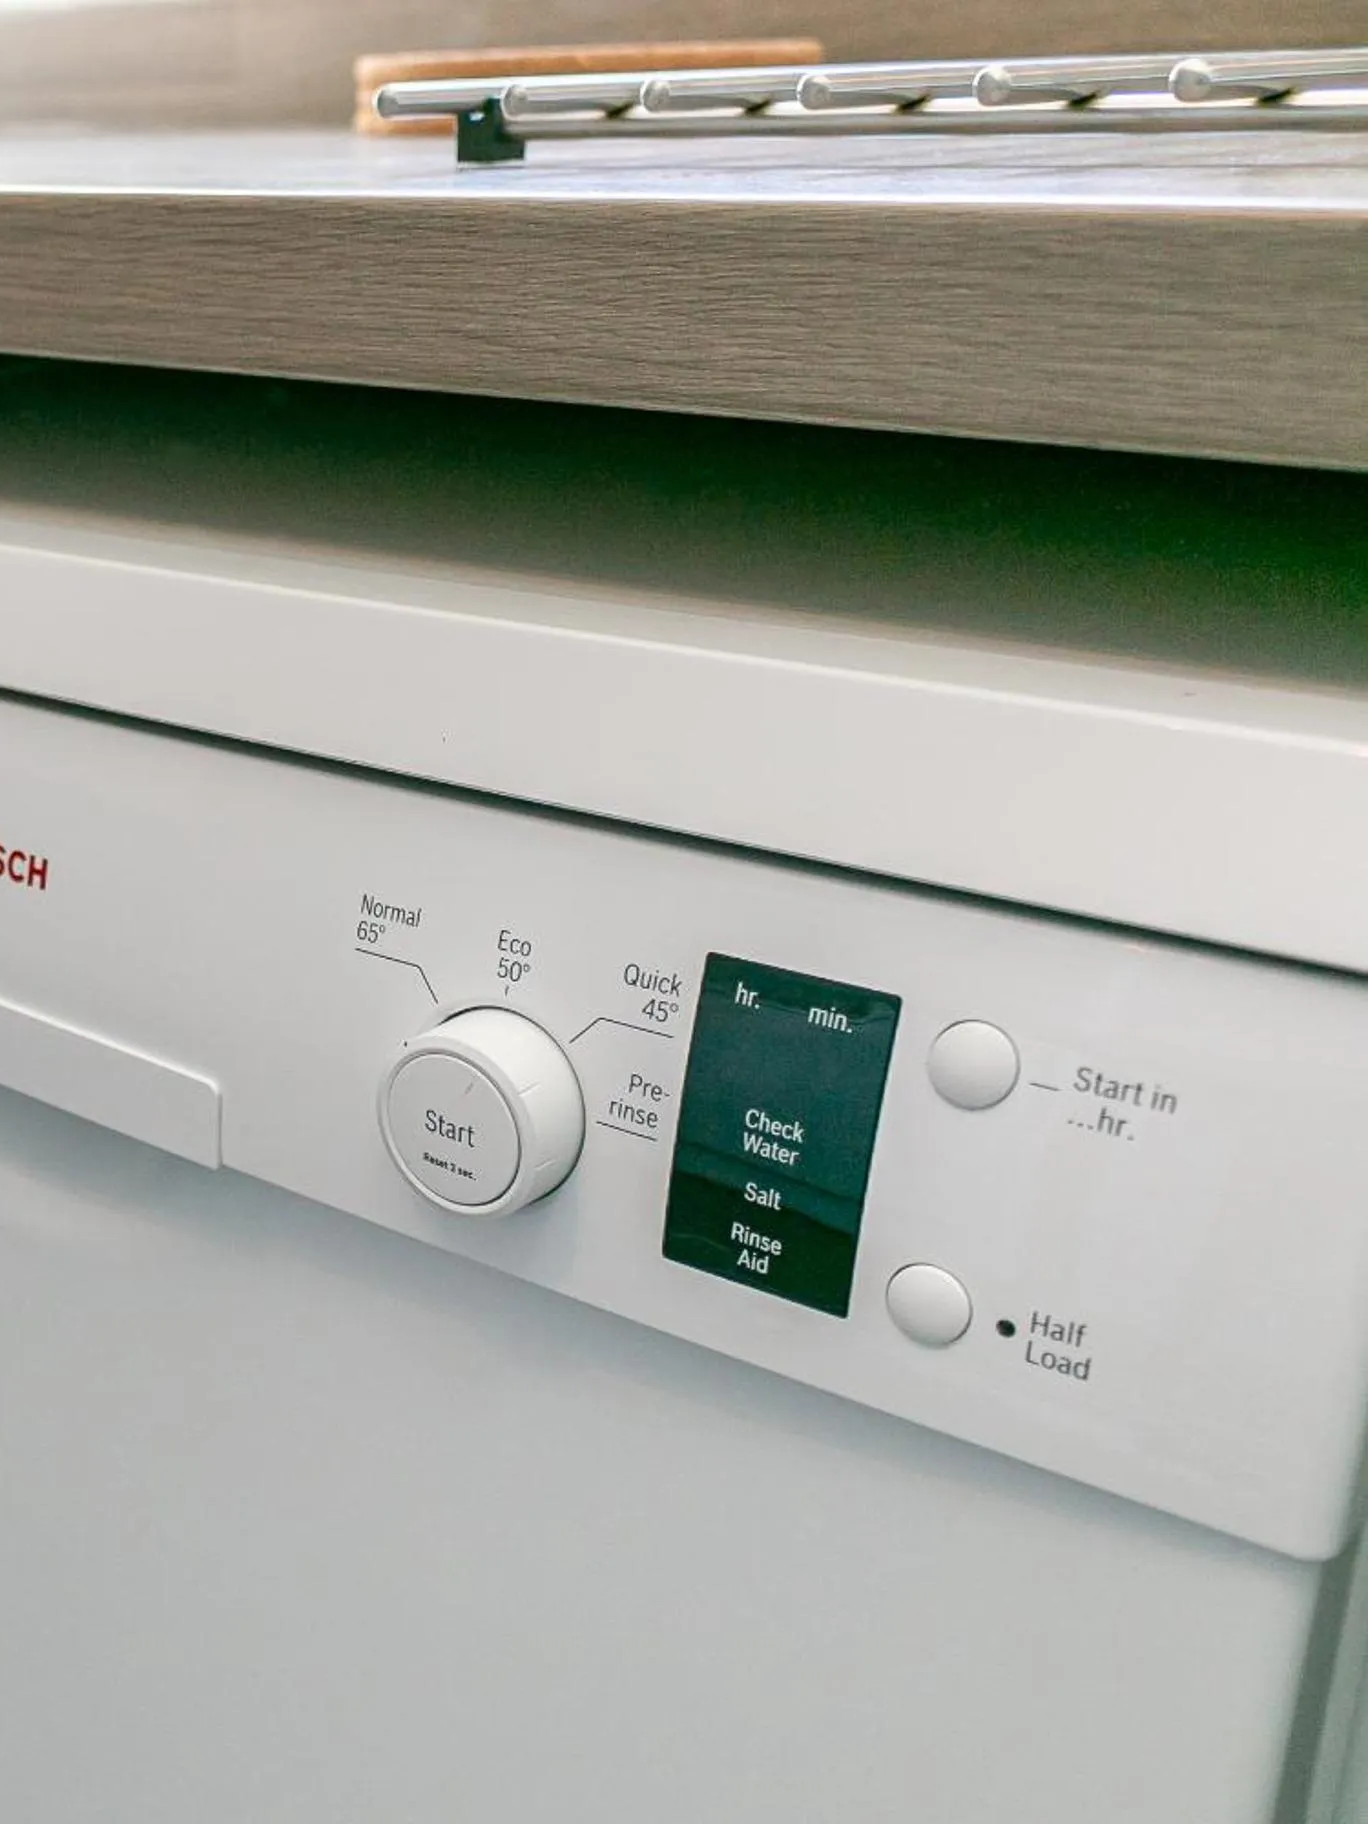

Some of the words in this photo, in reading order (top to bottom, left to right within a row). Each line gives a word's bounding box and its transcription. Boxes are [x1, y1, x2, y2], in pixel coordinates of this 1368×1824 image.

[360, 894, 423, 927] Normal
[497, 929, 532, 957] Eco
[623, 962, 682, 998] Quick
[735, 981, 761, 1009] hr.
[807, 1006, 853, 1034] min.
[628, 1073, 671, 1102] Pre-
[1072, 1065, 1143, 1107] Start
[1150, 1085, 1178, 1115] in
[424, 1108, 476, 1149] Start
[608, 1097, 659, 1128] rinse
[744, 1108, 805, 1143] Check
[743, 1131, 800, 1166] Water
[743, 1182, 781, 1211] Salt
[731, 1221, 782, 1256] Rinse
[737, 1249, 769, 1275] Aid
[1029, 1311, 1088, 1348] Half
[1024, 1340, 1092, 1382] Load
